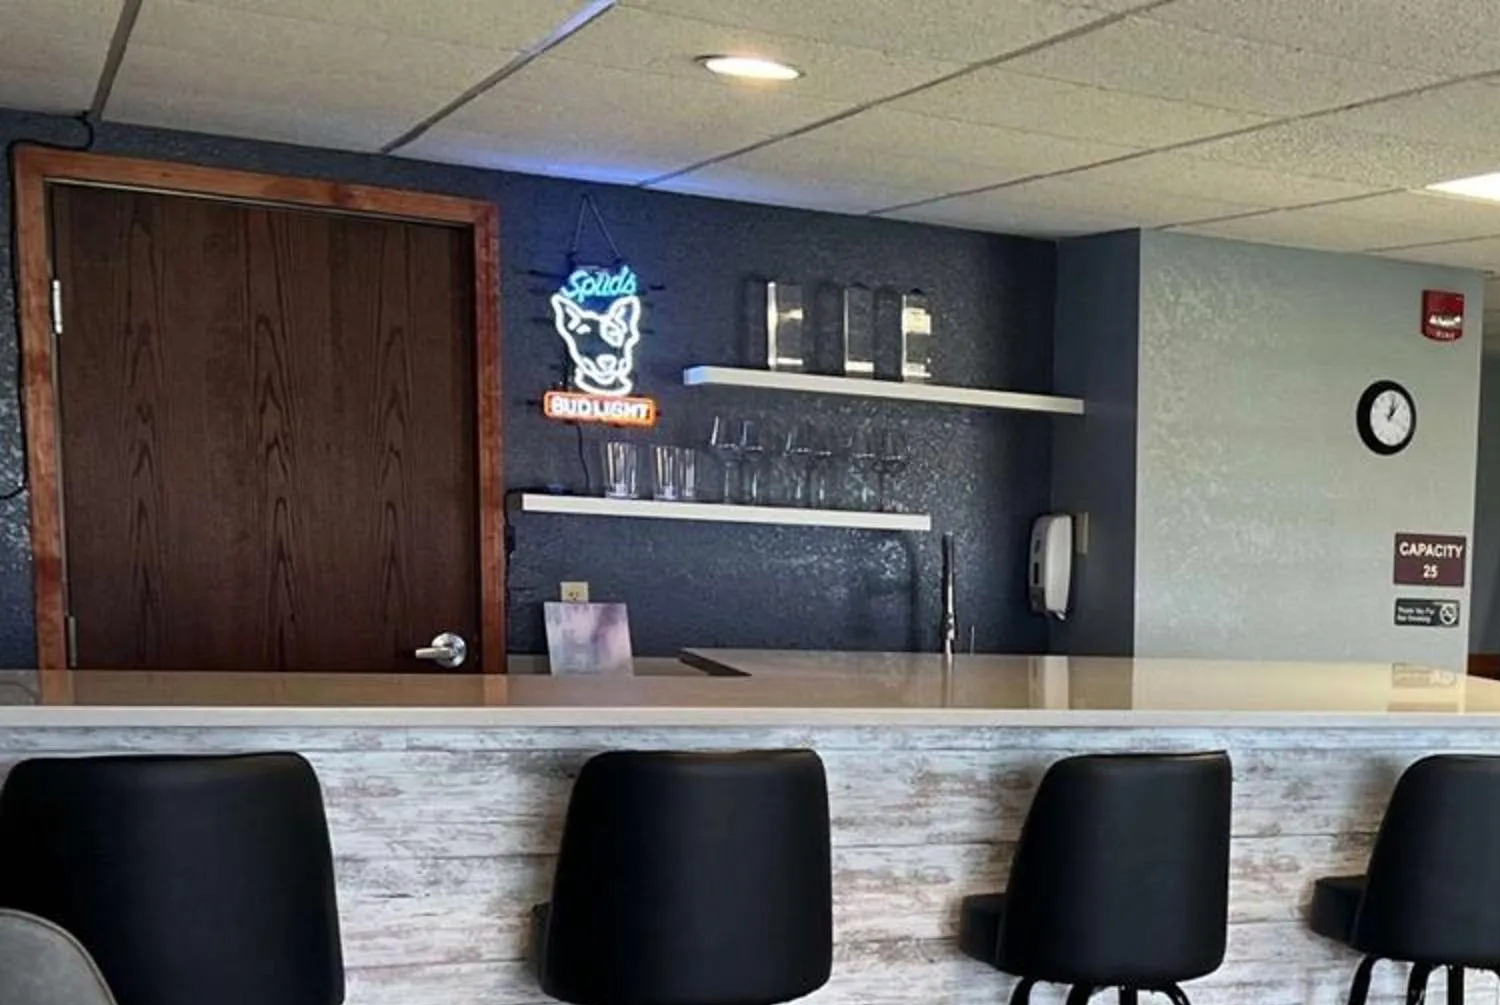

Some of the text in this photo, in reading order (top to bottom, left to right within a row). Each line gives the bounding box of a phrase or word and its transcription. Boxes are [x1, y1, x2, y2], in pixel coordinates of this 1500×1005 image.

[561, 264, 637, 303] Spuds
[552, 396, 649, 420] BUD LIGHT
[1399, 541, 1462, 558] CAPACITY
[1423, 564, 1438, 579] 25
